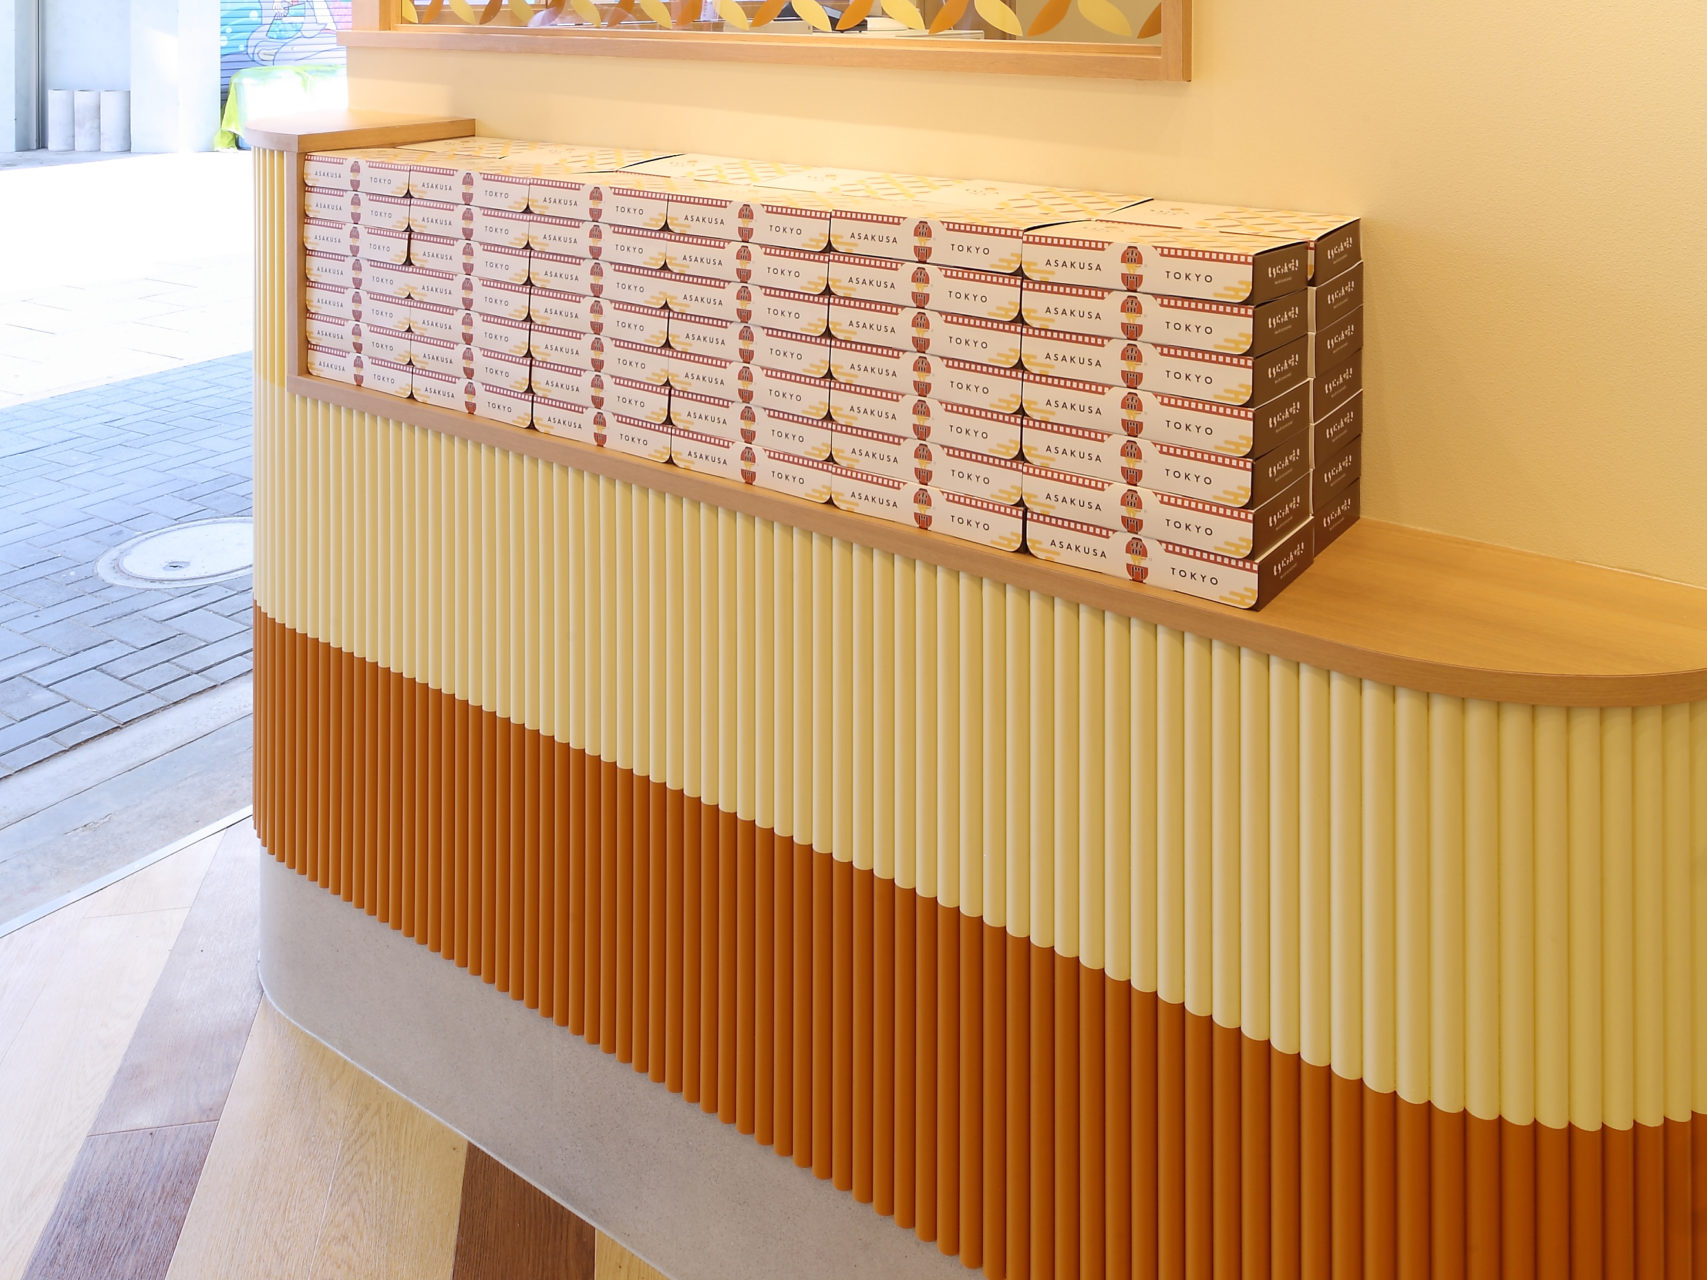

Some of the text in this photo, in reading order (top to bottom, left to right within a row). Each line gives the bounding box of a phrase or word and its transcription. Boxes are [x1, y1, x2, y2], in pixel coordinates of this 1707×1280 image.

[313, 170, 393, 186] ASAKUSA TOKYO
[421, 181, 510, 200] ASAKUSA TOKYO
[314, 201, 393, 220] ASAKUSA TOKYO
[542, 196, 645, 216] ASAKUSA TOKYO
[421, 216, 510, 236] ASAKUSA TOKYO
[683, 213, 803, 236] ASAKUSA TOKYO
[313, 234, 391, 253] ASAKUSA TOKYO
[542, 233, 644, 255] ASAKUSA TOKYO
[849, 231, 991, 256] ASAKUSA TOKYO
[422, 250, 510, 272] ASAKUSA TOKYO
[681, 254, 801, 279] ASAKUSA TOKYO
[1044, 258, 1214, 284] ASAKUSA TOKYO
[316, 265, 395, 286] ASAKUSA TOKYO
[543, 269, 646, 294] ASAKUSA TOKYO
[421, 284, 510, 307] ASAKUSA TOKYO
[847, 276, 988, 304] ASAKUSA TOKYO
[316, 297, 394, 319] ASAKUSA TOKYO
[543, 307, 645, 333] ASAKUSA TOKYO
[682, 293, 801, 320] ASAKUSA TOKYO
[421, 319, 510, 343] ASAKUSA TOKYO
[1044, 305, 1214, 336] ASAKUSA TOKYO
[316, 329, 395, 352] ASAKUSA TOKYO
[684, 332, 803, 361] ASAKUSA TOKYO
[847, 319, 989, 350] ASAKUSA TOKYO
[422, 352, 510, 379] ASAKUSA TOKYO
[543, 343, 647, 370] ASAKUSA TOKYO
[1044, 352, 1214, 386] ASAKUSA TOKYO
[317, 360, 396, 385] ASAKUSA TOKYO
[849, 362, 990, 395] ASAKUSA TOKYO
[424, 386, 513, 414] ASAKUSA TOKYO
[544, 379, 646, 409] ASAKUSA TOKYO
[684, 371, 803, 403] ASAKUSA TOKYO
[686, 410, 805, 444] ASAKUSA TOKYO
[848, 404, 989, 440] ASAKUSA TOKYO
[1045, 398, 1214, 436] ASAKUSA TOKYO
[546, 415, 649, 447] ASAKUSA TOKYO
[687, 450, 805, 486] ASAKUSA TOKYO
[850, 447, 991, 486] ASAKUSA TOKYO
[1045, 444, 1213, 486] ASAKUSA TOKYO
[849, 490, 991, 532] ASAKUSA TOKYO
[1044, 492, 1214, 537] ASAKUSA TOKYO
[1049, 538, 1219, 586] ASAKUSA TOKYO
